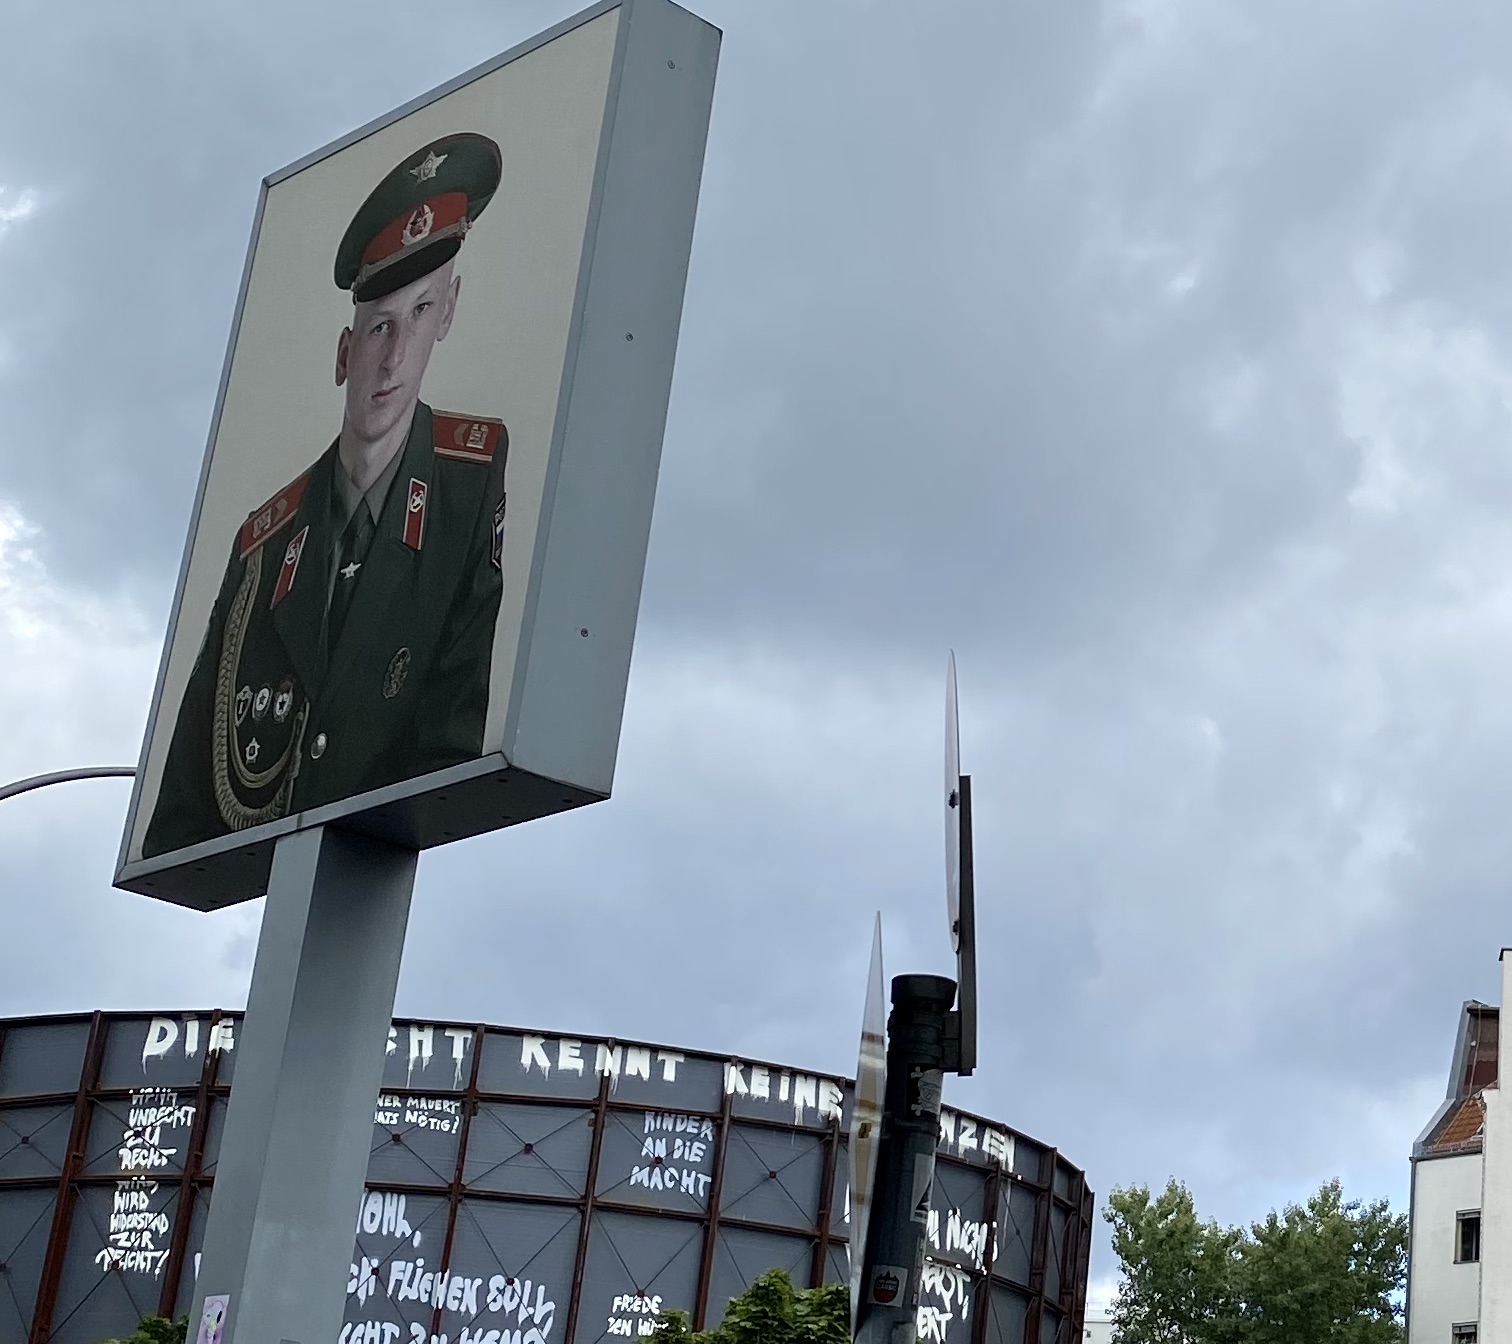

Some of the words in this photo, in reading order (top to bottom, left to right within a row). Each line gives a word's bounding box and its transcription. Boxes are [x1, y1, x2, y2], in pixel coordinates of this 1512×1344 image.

[142, 1016, 235, 1060] DIE
[519, 1032, 685, 1084] KENNT
[129, 1107, 196, 1129] UNRECHT
[407, 1096, 459, 1115] MAUERT
[405, 1109, 459, 1134] NÖTIG!
[644, 1112, 714, 1142] KINDER
[124, 1127, 160, 1148] ZU
[641, 1137, 666, 1162] AN
[673, 1140, 706, 1163] DIE
[118, 1148, 177, 1170] RECHT
[629, 1166, 712, 1197] MACHT
